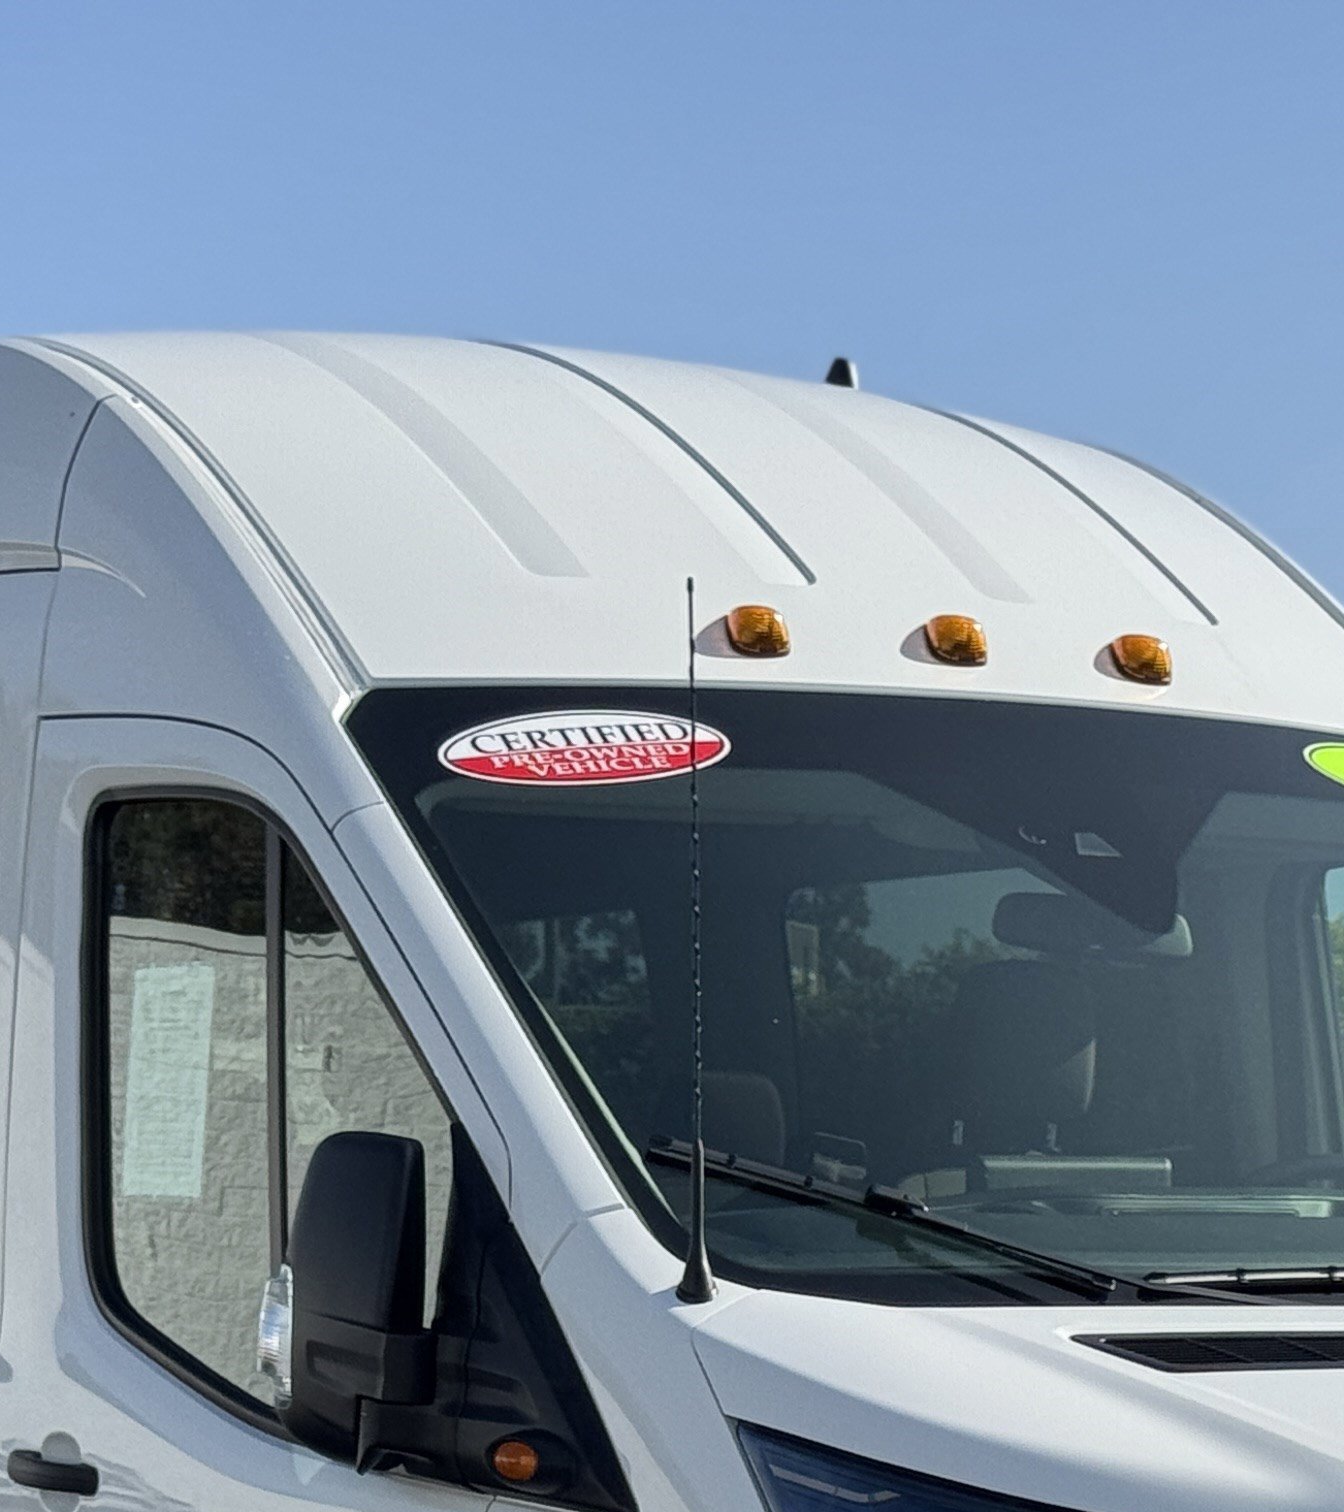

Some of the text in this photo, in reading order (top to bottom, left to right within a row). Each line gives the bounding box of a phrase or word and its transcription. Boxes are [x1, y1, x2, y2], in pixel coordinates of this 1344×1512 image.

[470, 721, 690, 755] CERTIFIED
[488, 742, 690, 770] PRE-OWNED
[526, 756, 673, 779] VEHICLE
